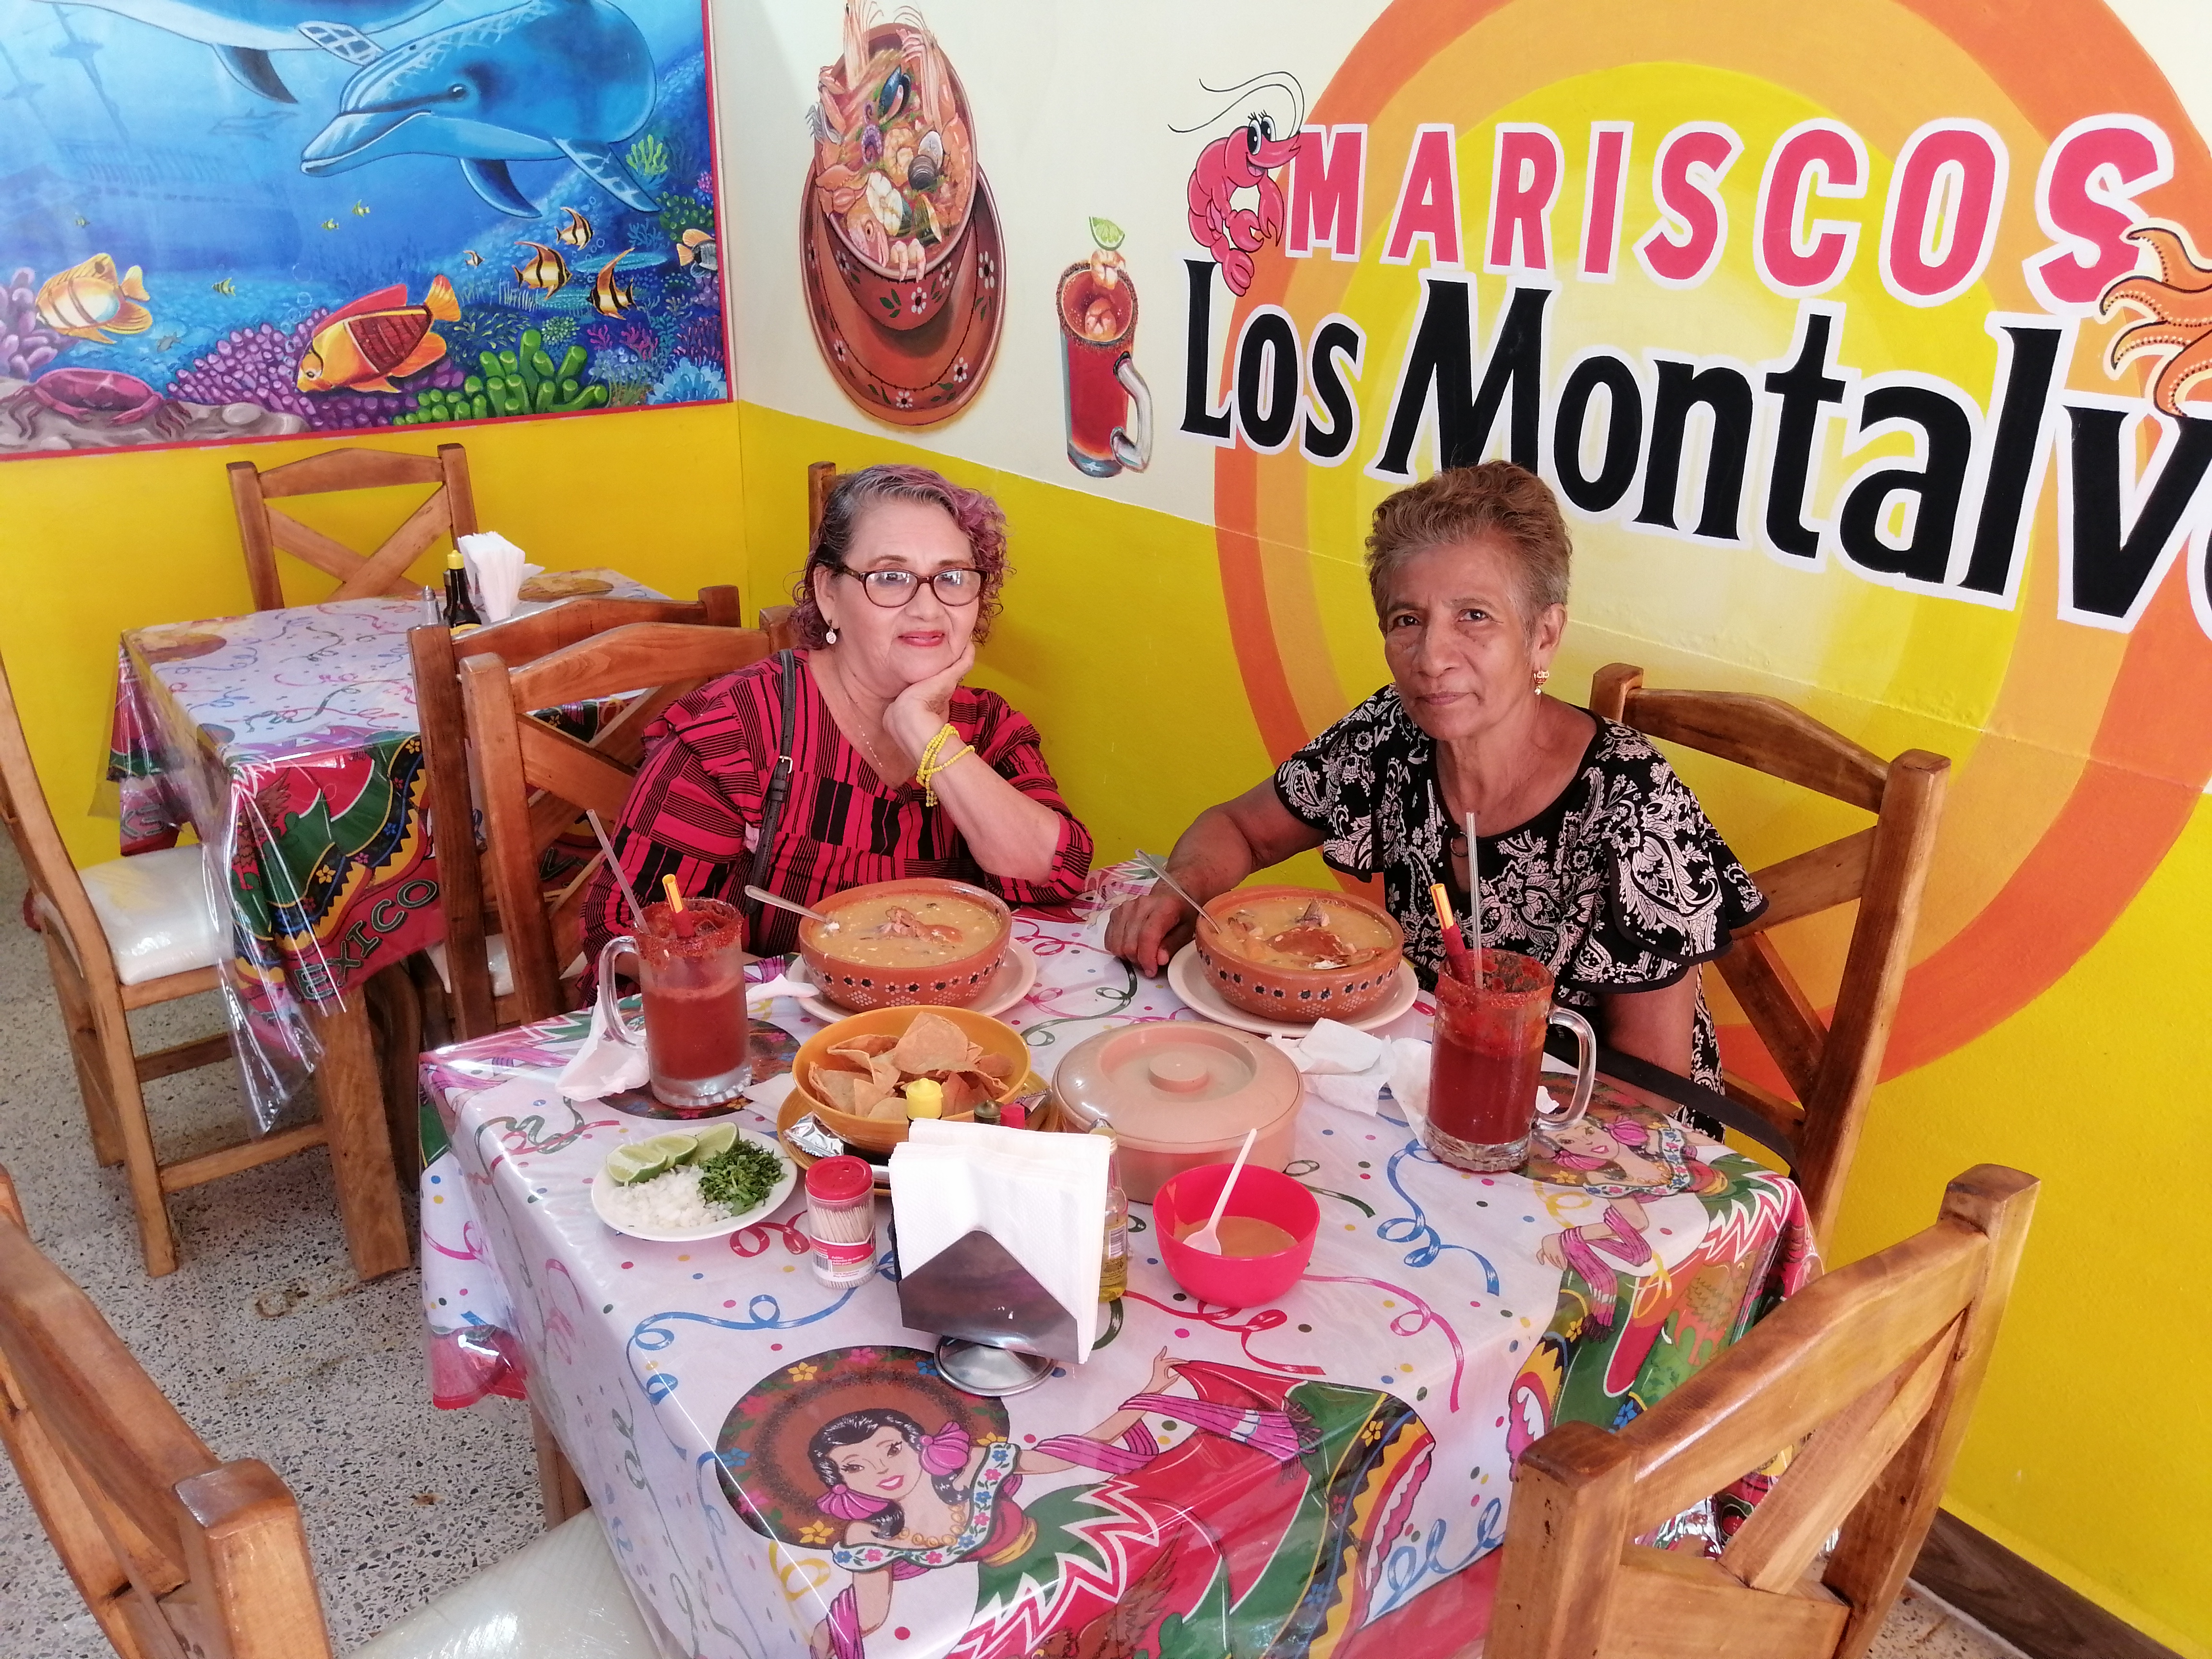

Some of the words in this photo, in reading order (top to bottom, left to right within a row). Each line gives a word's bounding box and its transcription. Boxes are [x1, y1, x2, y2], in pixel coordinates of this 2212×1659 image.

[1287, 126, 2160, 303] MARISCOS
[1179, 258, 1360, 458] Los
[1375, 277, 2212, 618] Montalv
